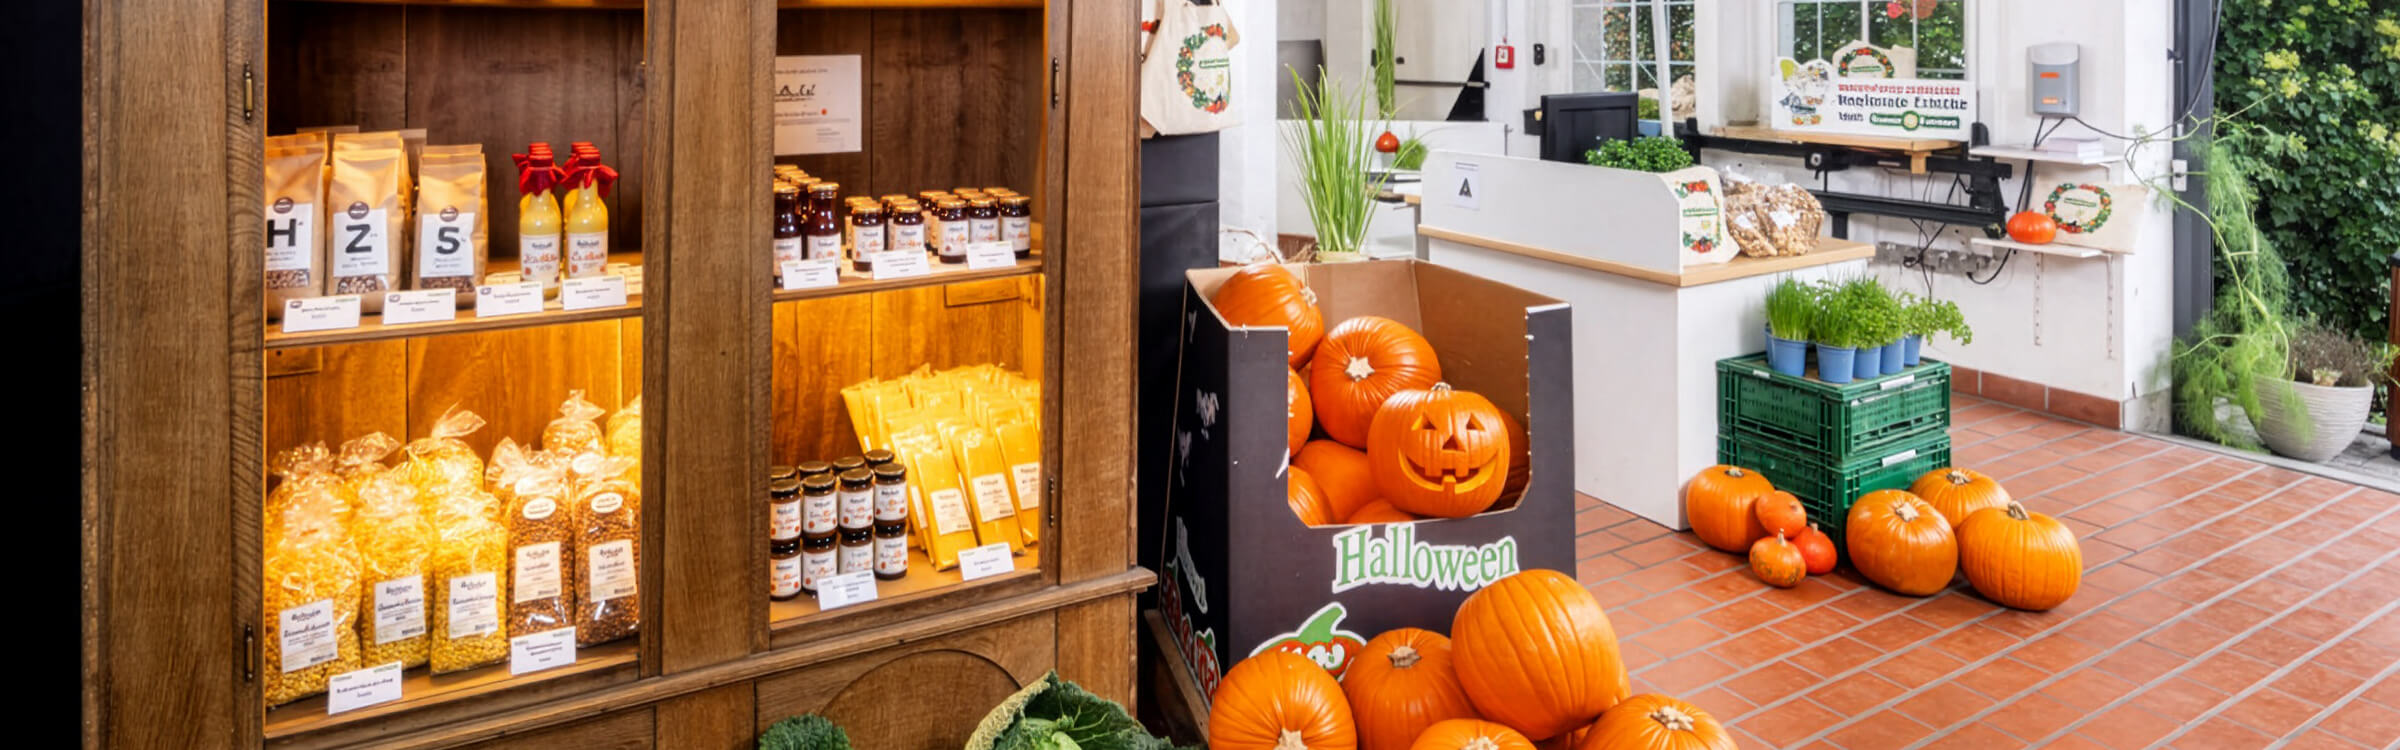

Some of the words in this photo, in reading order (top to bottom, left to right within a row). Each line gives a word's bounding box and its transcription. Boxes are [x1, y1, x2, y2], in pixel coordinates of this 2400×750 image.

[266, 218, 297, 248] H
[345, 224, 372, 253] Z
[436, 227, 461, 255] S
[1336, 524, 1518, 589] Halloween
